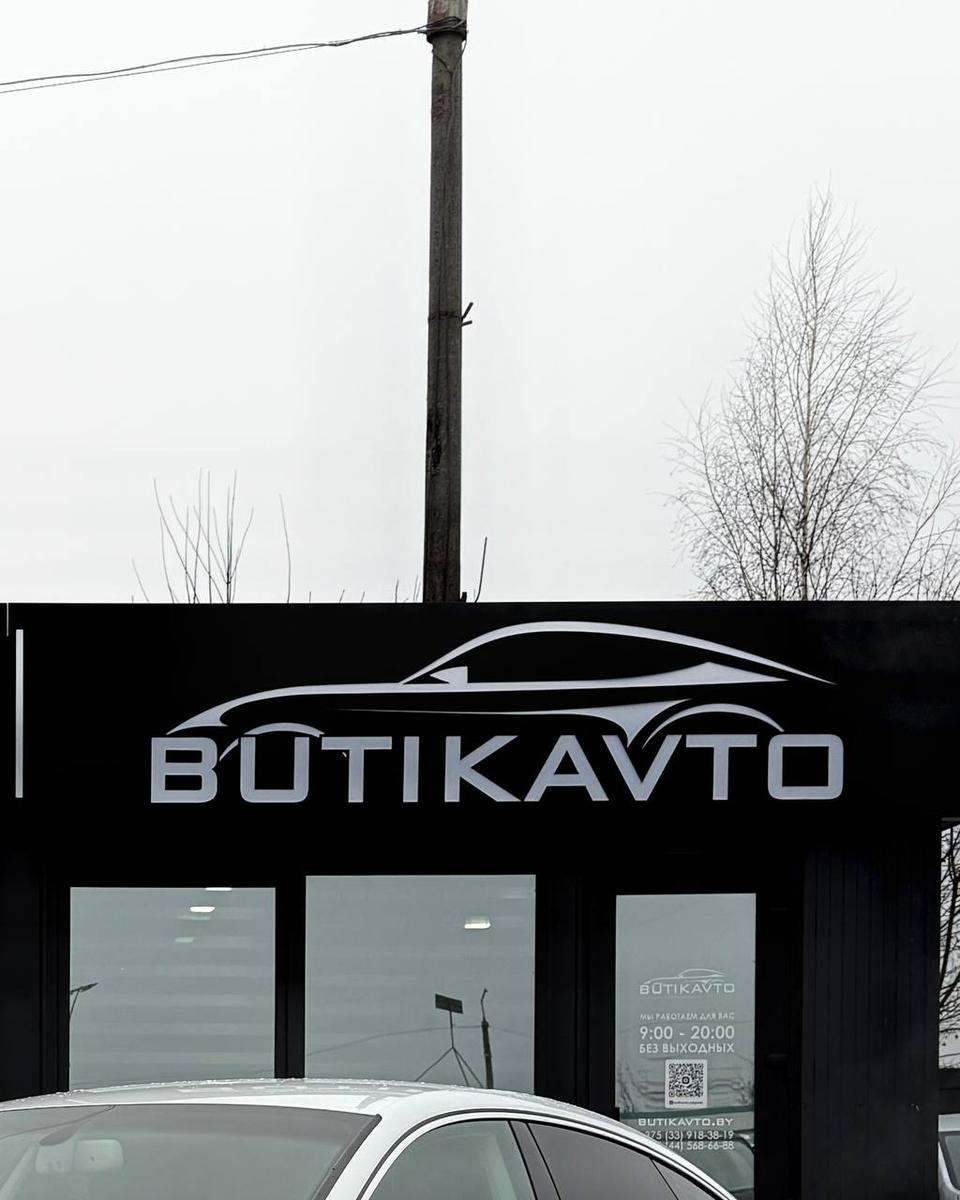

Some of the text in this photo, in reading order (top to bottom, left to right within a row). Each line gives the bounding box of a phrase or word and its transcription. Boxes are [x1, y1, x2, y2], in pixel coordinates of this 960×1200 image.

[149, 731, 846, 804] BUTIKAVTO
[639, 983, 735, 995] BUTIKAVTO
[656, 1012, 698, 1020] РАБОТАЕМ
[640, 1025, 673, 1040] 9:00
[690, 1025, 735, 1040] 20:00
[639, 1043, 734, 1054] БЕЗ ВЫХОДНЫХ
[638, 1118, 734, 1126] BUTIKAVTO.BY
[665, 1130, 683, 1141] (33)
[686, 1131, 734, 1140] 918-38-19
[686, 1141, 734, 1150] 568-66-88
